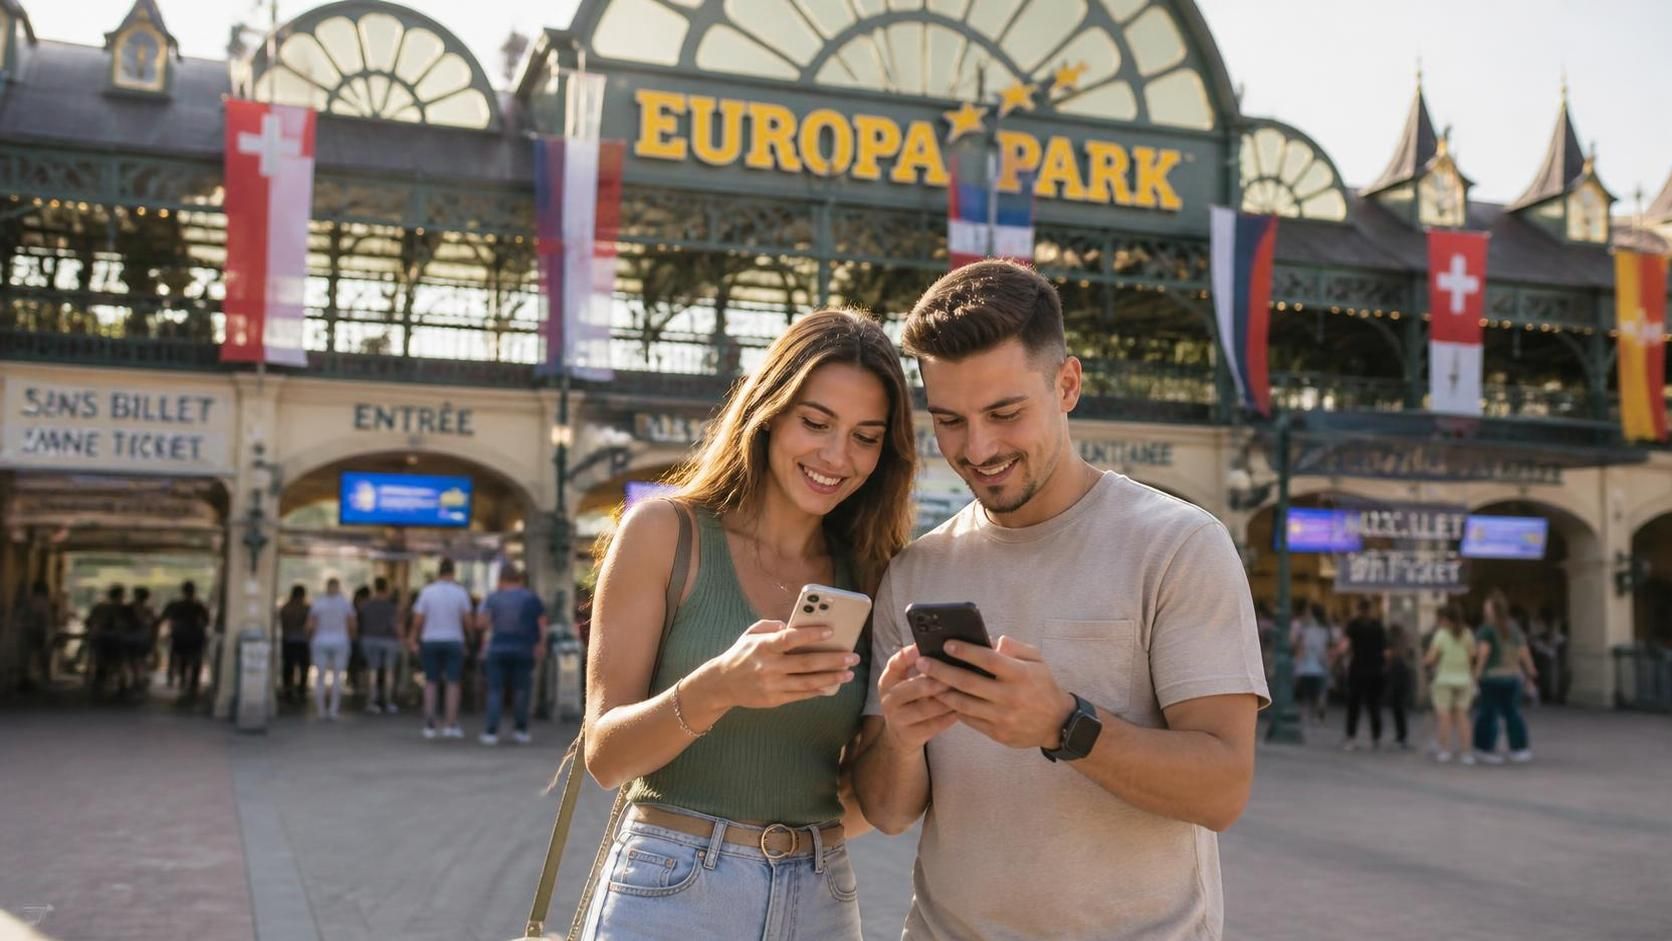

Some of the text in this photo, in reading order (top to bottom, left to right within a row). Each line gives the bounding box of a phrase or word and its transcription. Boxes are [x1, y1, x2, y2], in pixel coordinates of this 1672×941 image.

[635, 88, 1183, 211] EUROPA PARK
[110, 391, 214, 422] BILLET
